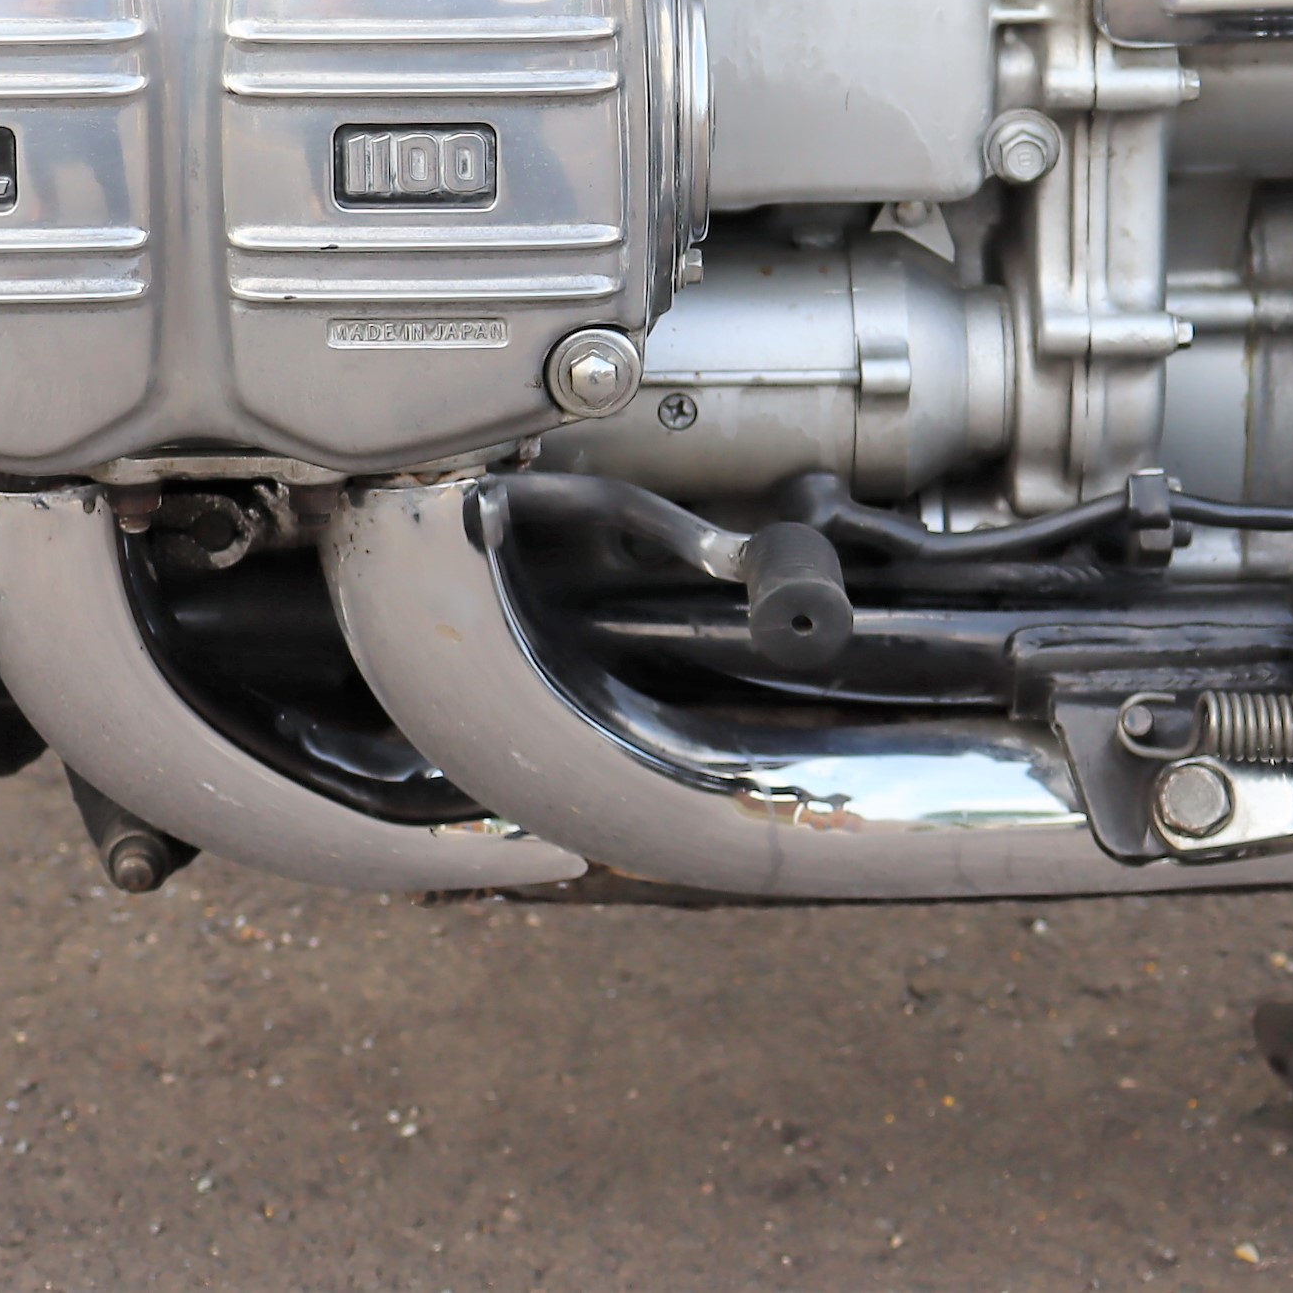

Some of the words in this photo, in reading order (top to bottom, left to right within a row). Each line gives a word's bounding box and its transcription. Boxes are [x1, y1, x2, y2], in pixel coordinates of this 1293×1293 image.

[345, 131, 489, 194] 1100
[331, 322, 396, 342] MADE
[402, 322, 426, 341] IN
[433, 321, 505, 342] JAPAN
